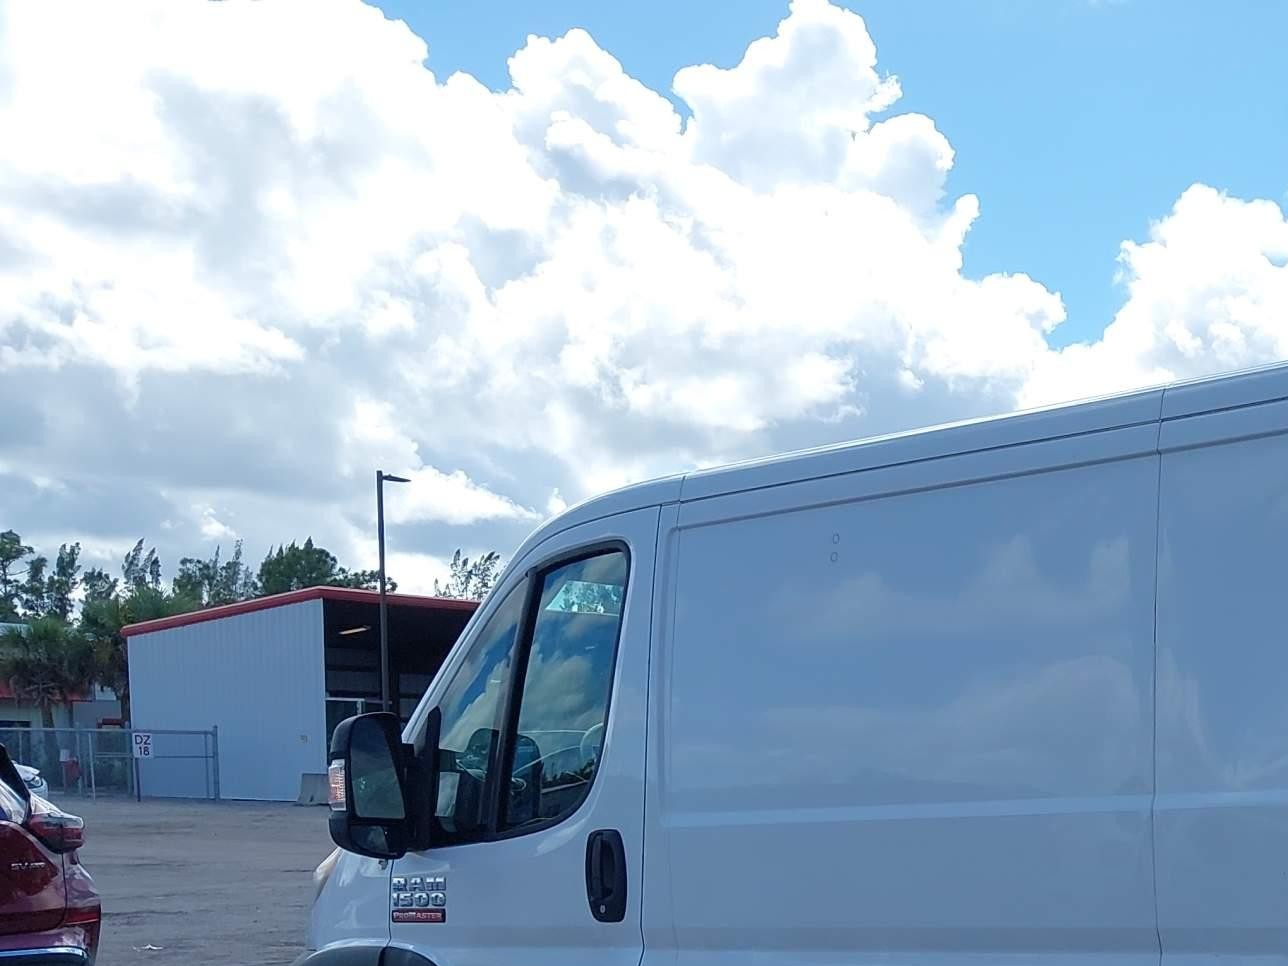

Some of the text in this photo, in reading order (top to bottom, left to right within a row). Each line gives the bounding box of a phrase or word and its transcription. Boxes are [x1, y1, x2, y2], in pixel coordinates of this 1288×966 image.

[134, 734, 152, 746] DZ
[391, 877, 447, 892] RAM
[391, 892, 447, 908] 1500
